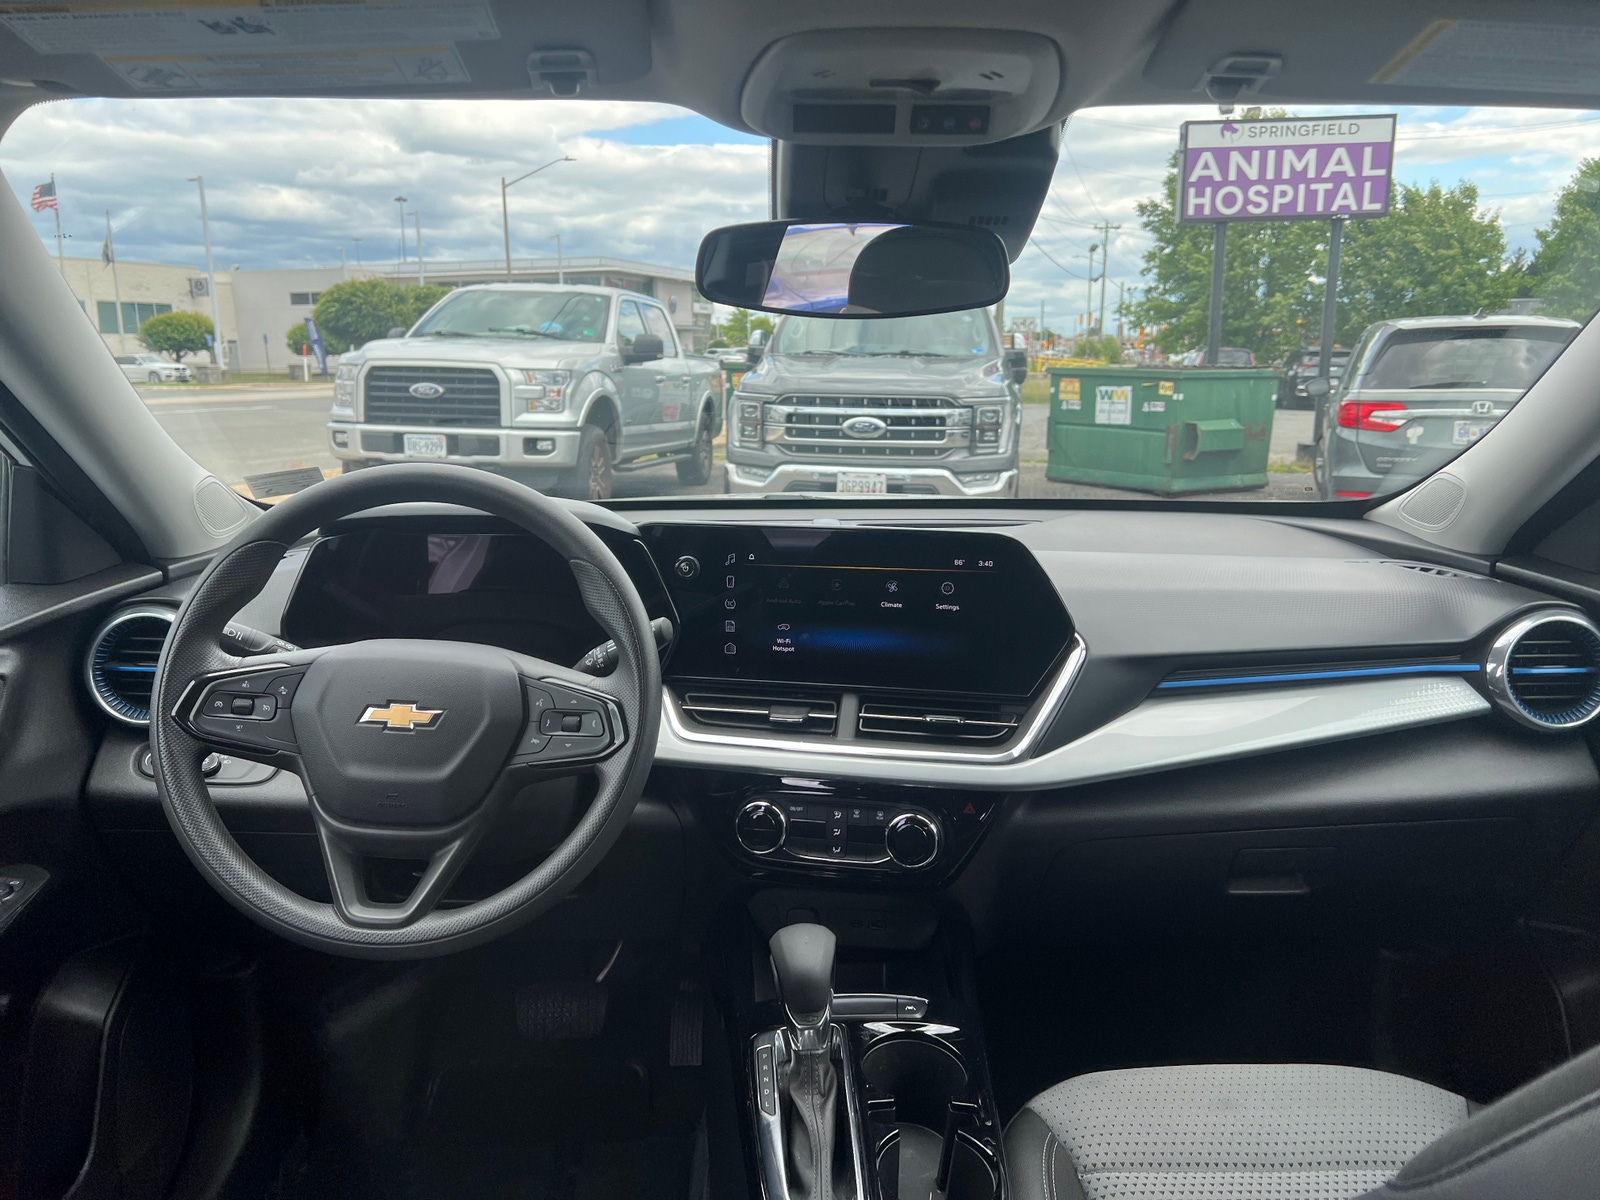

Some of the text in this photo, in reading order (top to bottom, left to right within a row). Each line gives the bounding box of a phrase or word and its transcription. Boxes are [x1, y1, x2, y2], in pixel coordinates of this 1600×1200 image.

[1247, 122, 1361, 139] SPRINGFIELD
[1187, 146, 1387, 183] ANIMAL
[1186, 181, 1382, 216] HOSPITAL
[1099, 389, 1127, 401] WM
[880, 601, 903, 609] Climate
[935, 603, 960, 611] Settings
